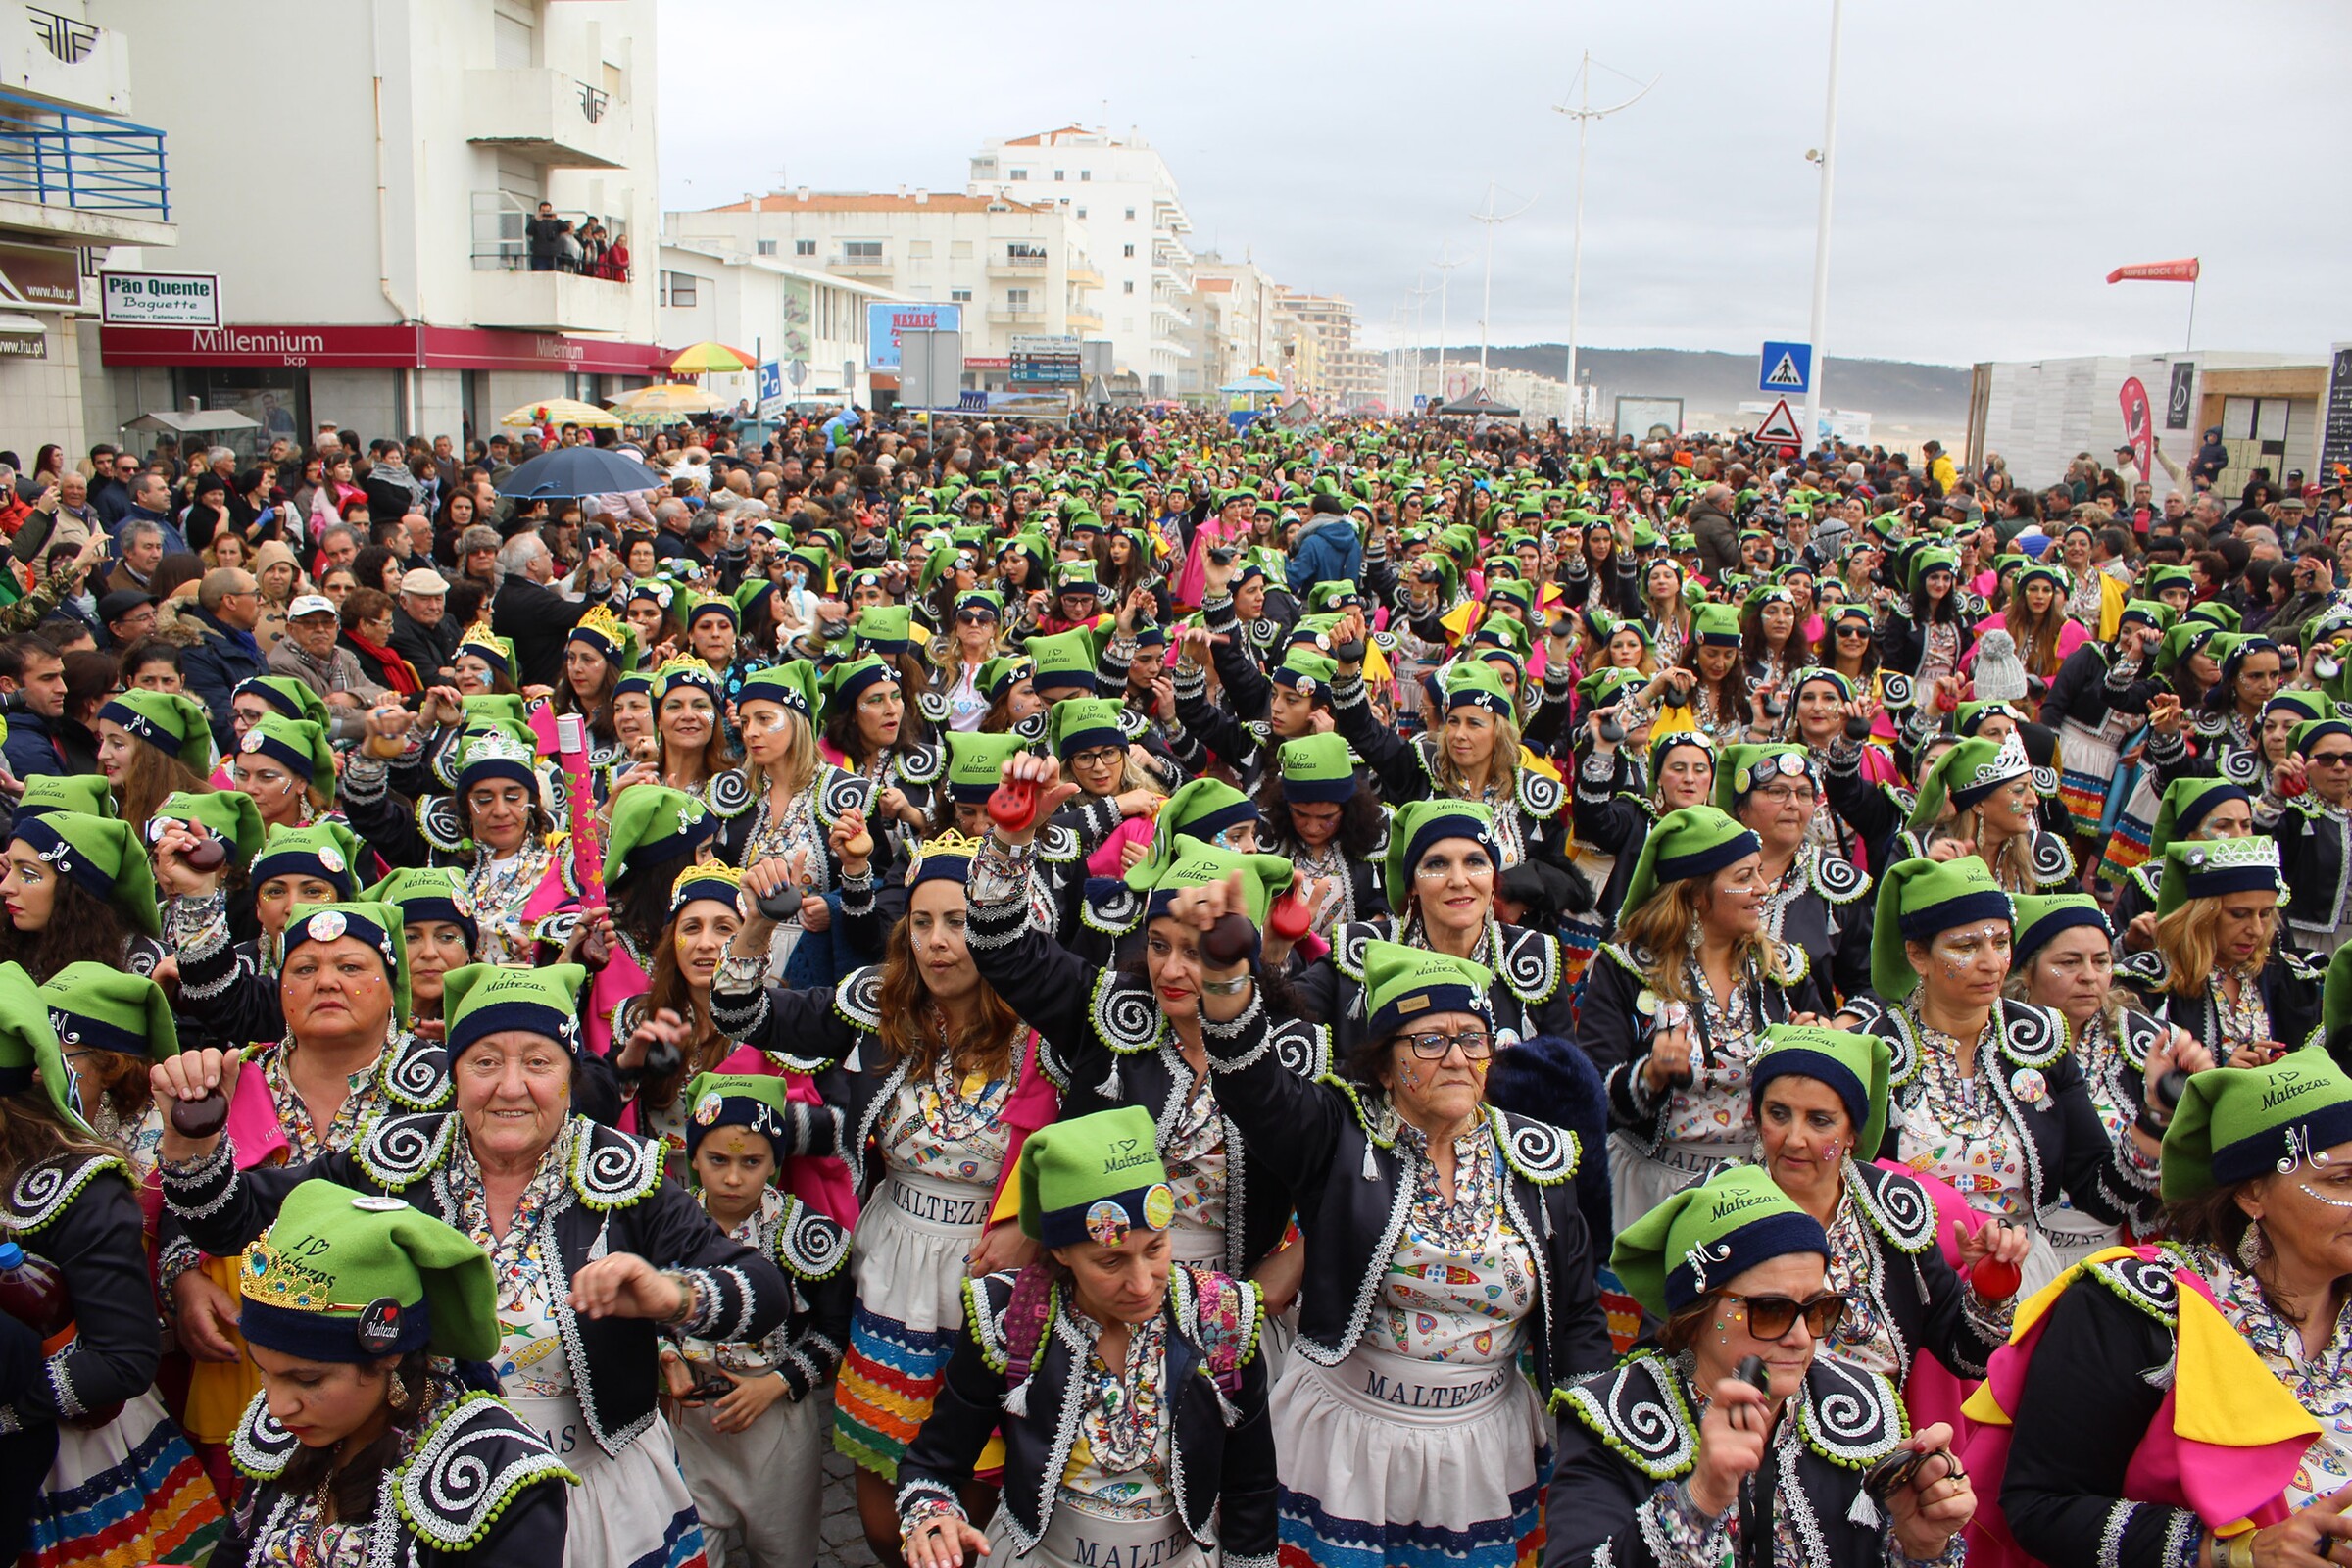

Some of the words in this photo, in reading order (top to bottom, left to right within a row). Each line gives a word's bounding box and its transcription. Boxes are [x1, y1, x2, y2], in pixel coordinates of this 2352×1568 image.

[2147, 266, 2172, 276] BOCK
[27, 285, 75, 303] www.itu.pt
[109, 277, 143, 294] Pão
[148, 278, 210, 297] Quente
[123, 297, 197, 312] Baguette
[893, 311, 938, 328] NAZARÉ
[192, 329, 324, 352] Millennium
[536, 336, 584, 360] Millennium
[284, 354, 307, 368] bcp
[1042, 655, 1070, 665] Maltezas
[1077, 713, 1107, 723] Maltezas
[960, 764, 997, 773] Maltezas
[1286, 760, 1317, 769] Maltezas
[271, 835, 313, 849] Maltezas
[403, 879, 451, 890] Maltezas
[480, 979, 547, 997] Maltezas
[1778, 1035, 1837, 1049] Maltezas
[706, 1081, 754, 1093] Maltezas
[2268, 1075, 2278, 1087] I
[2261, 1078, 2332, 1112] Maltezas
[1108, 1144, 1118, 1154] I
[1710, 1195, 1781, 1223] Maltezas
[293, 1235, 315, 1251] I
[373, 1307, 383, 1320] I
[365, 1320, 400, 1339] Maltezas
